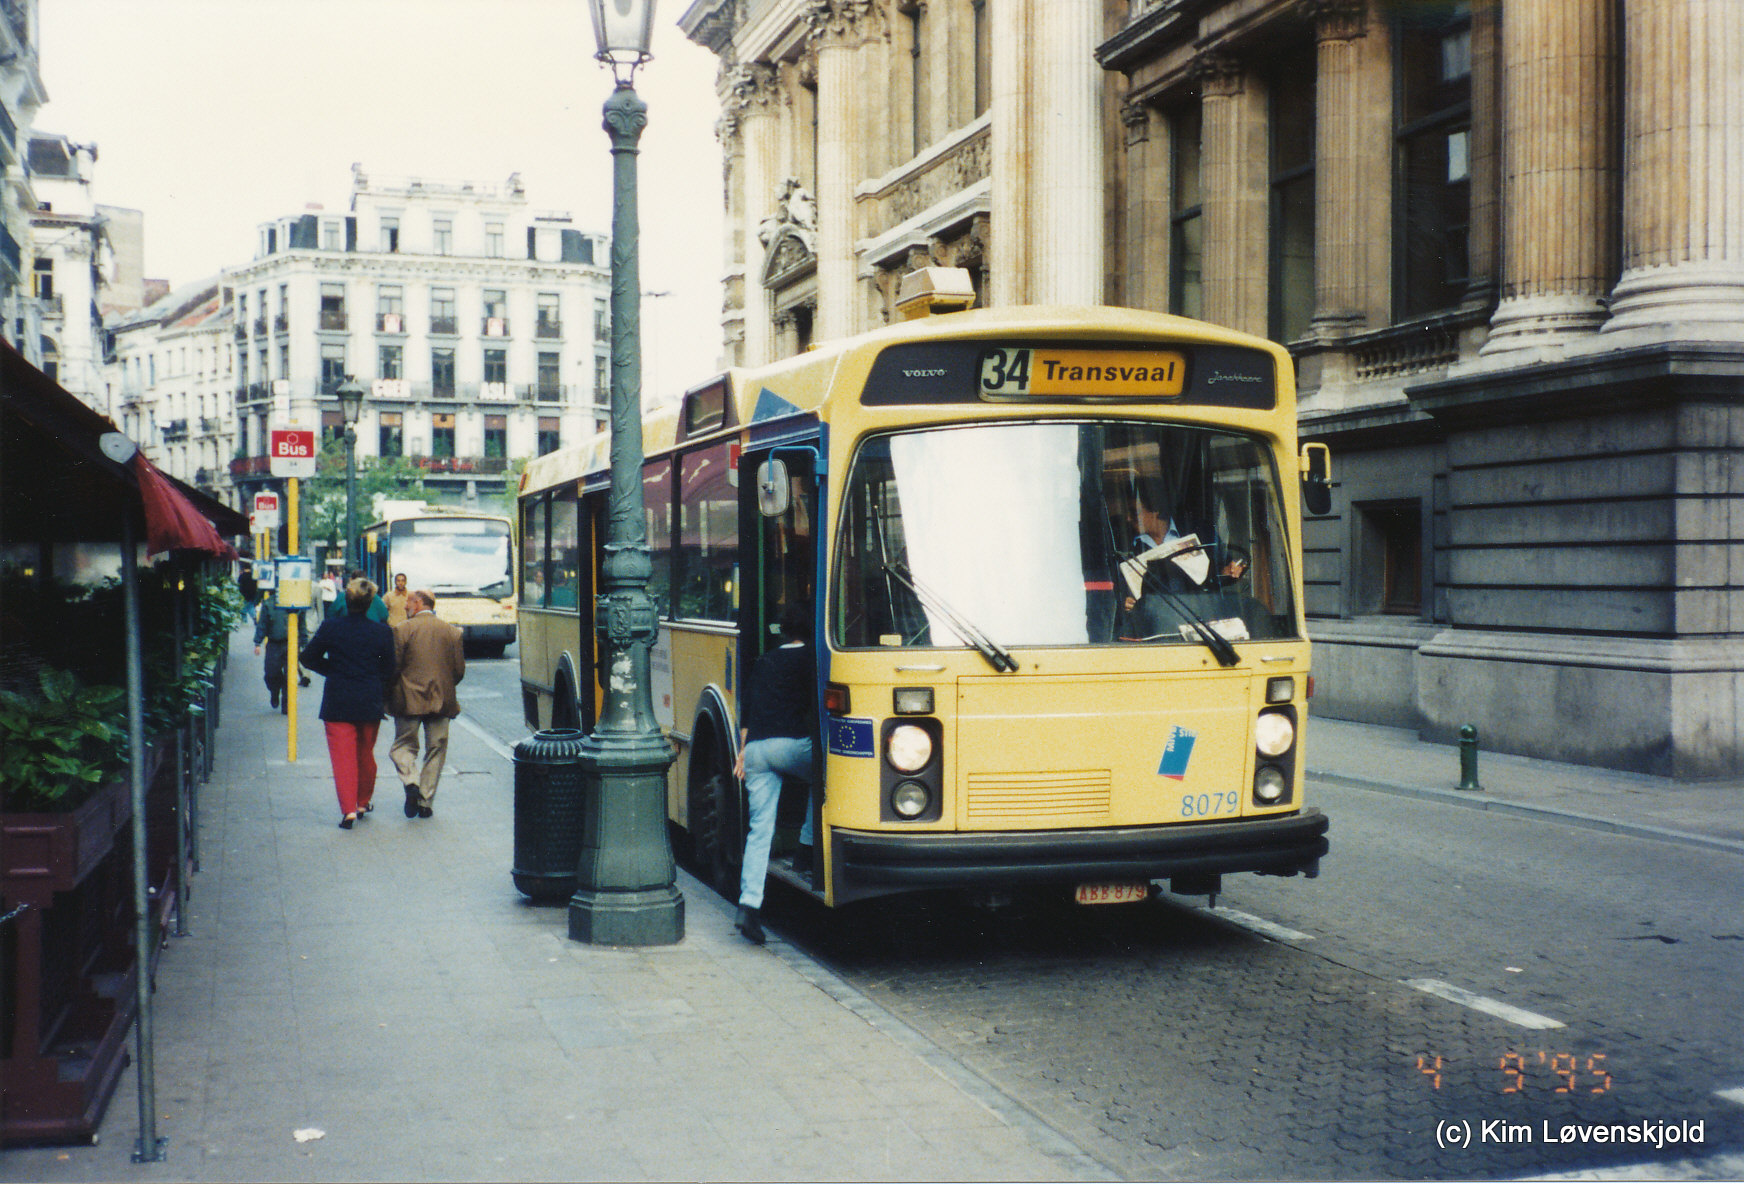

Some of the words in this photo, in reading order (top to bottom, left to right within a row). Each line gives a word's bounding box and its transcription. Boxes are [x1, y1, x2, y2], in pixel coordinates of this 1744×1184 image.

[902, 368, 947, 377] VOLVO
[983, 349, 1029, 390] 34
[1043, 360, 1175, 382] Transvaal
[278, 442, 308, 456] Bus
[258, 502, 275, 510] Bus
[1181, 791, 1238, 817] 8079
